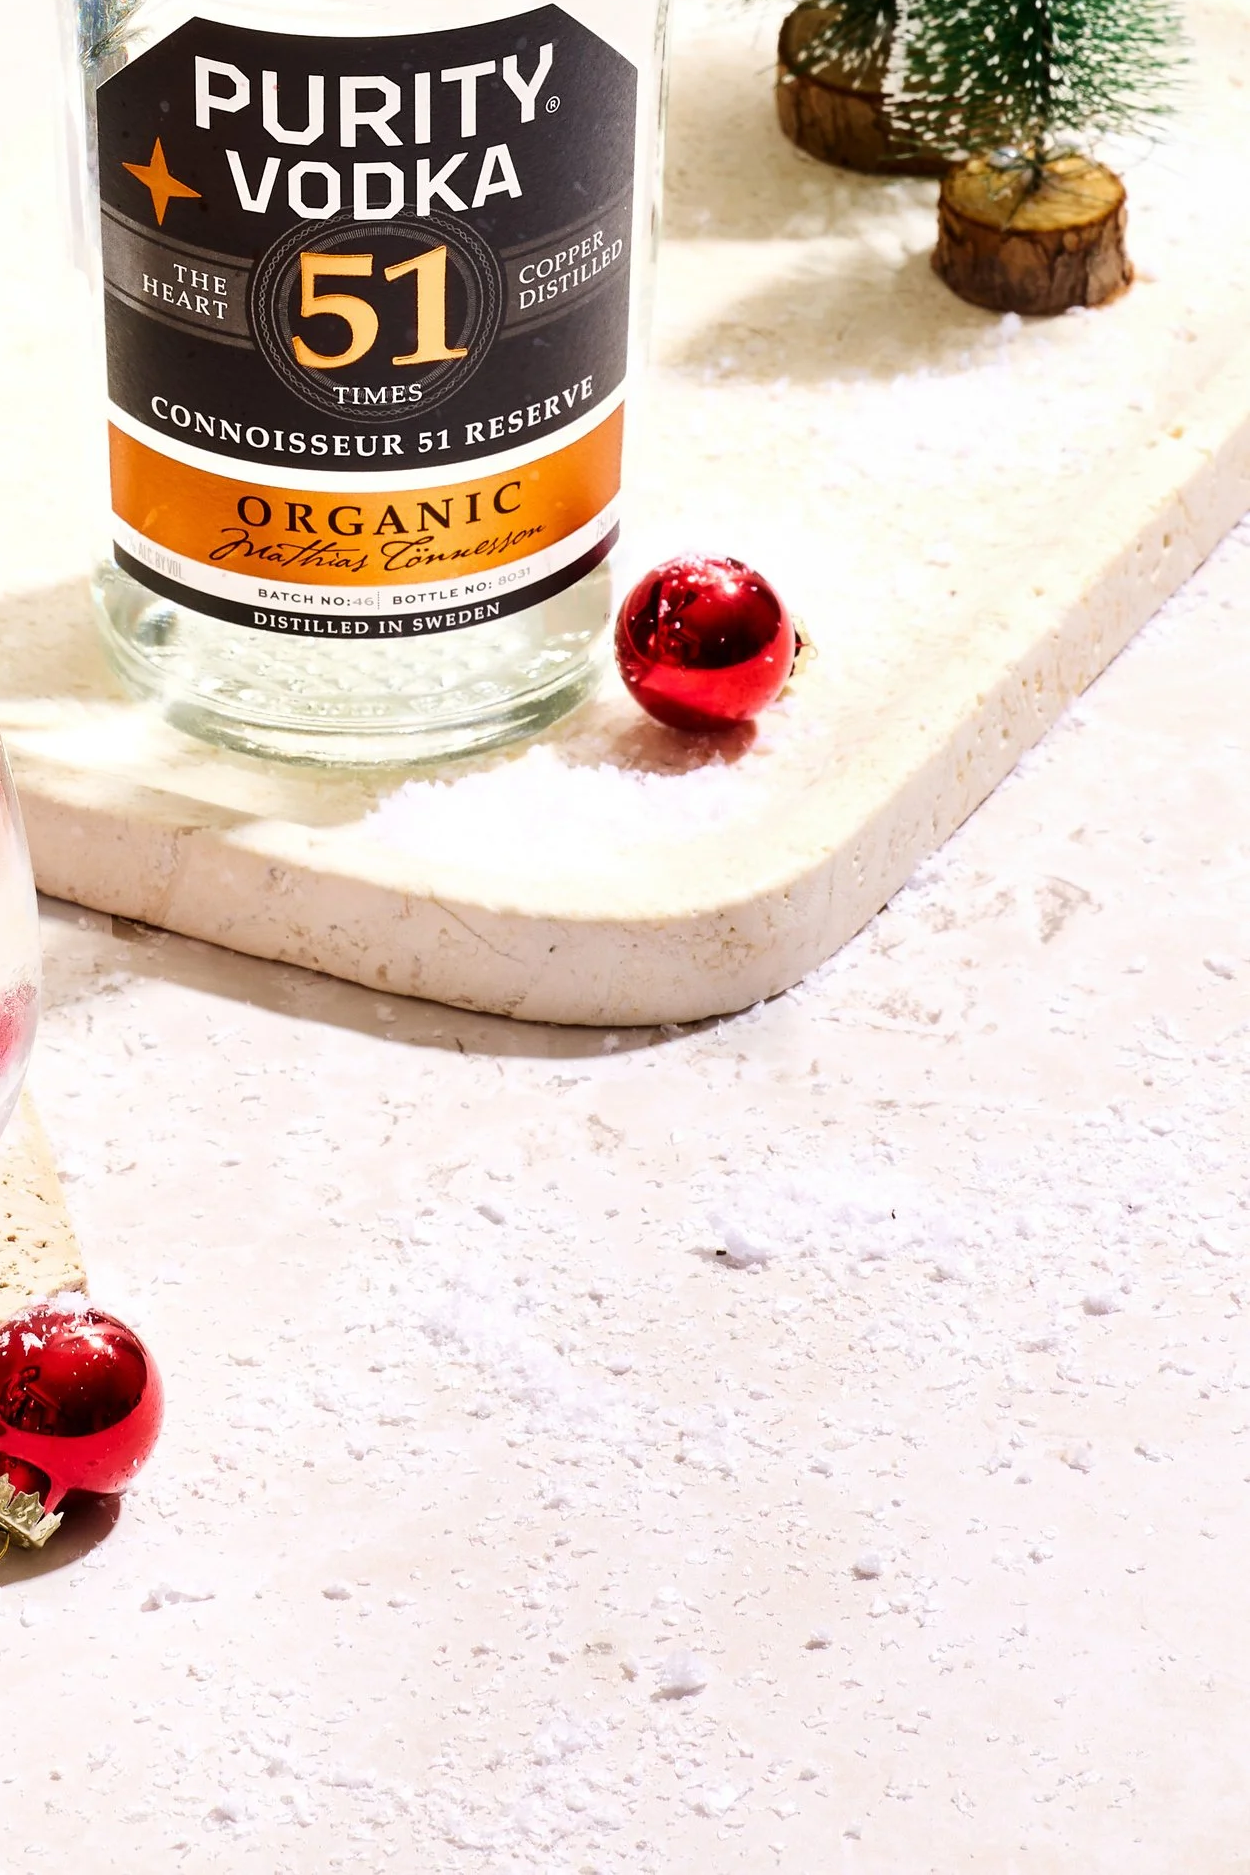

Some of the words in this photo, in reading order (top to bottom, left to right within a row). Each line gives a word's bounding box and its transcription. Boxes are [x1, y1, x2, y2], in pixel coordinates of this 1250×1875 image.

[225, 143, 523, 222] VODKA
[173, 263, 228, 296] THE
[518, 230, 604, 284] COPPER
[518, 238, 623, 310] DISTILLED
[142, 273, 229, 320] HEART
[290, 244, 470, 370] 51
[150, 395, 404, 458] CONNOISSEUR
[417, 429, 452, 454] 51
[464, 375, 594, 446] RESERVE
[332, 383, 424, 405] TIMES
[236, 481, 523, 538] ORGANIC
[208, 527, 369, 573] Mathias
[257, 588, 314, 606] BATCH
[392, 587, 460, 606] BOTTLE
[464, 580, 492, 595] NO:
[253, 610, 369, 635] DISTILLED
[378, 619, 403, 635] IN
[412, 601, 501, 633] SWEDEN
